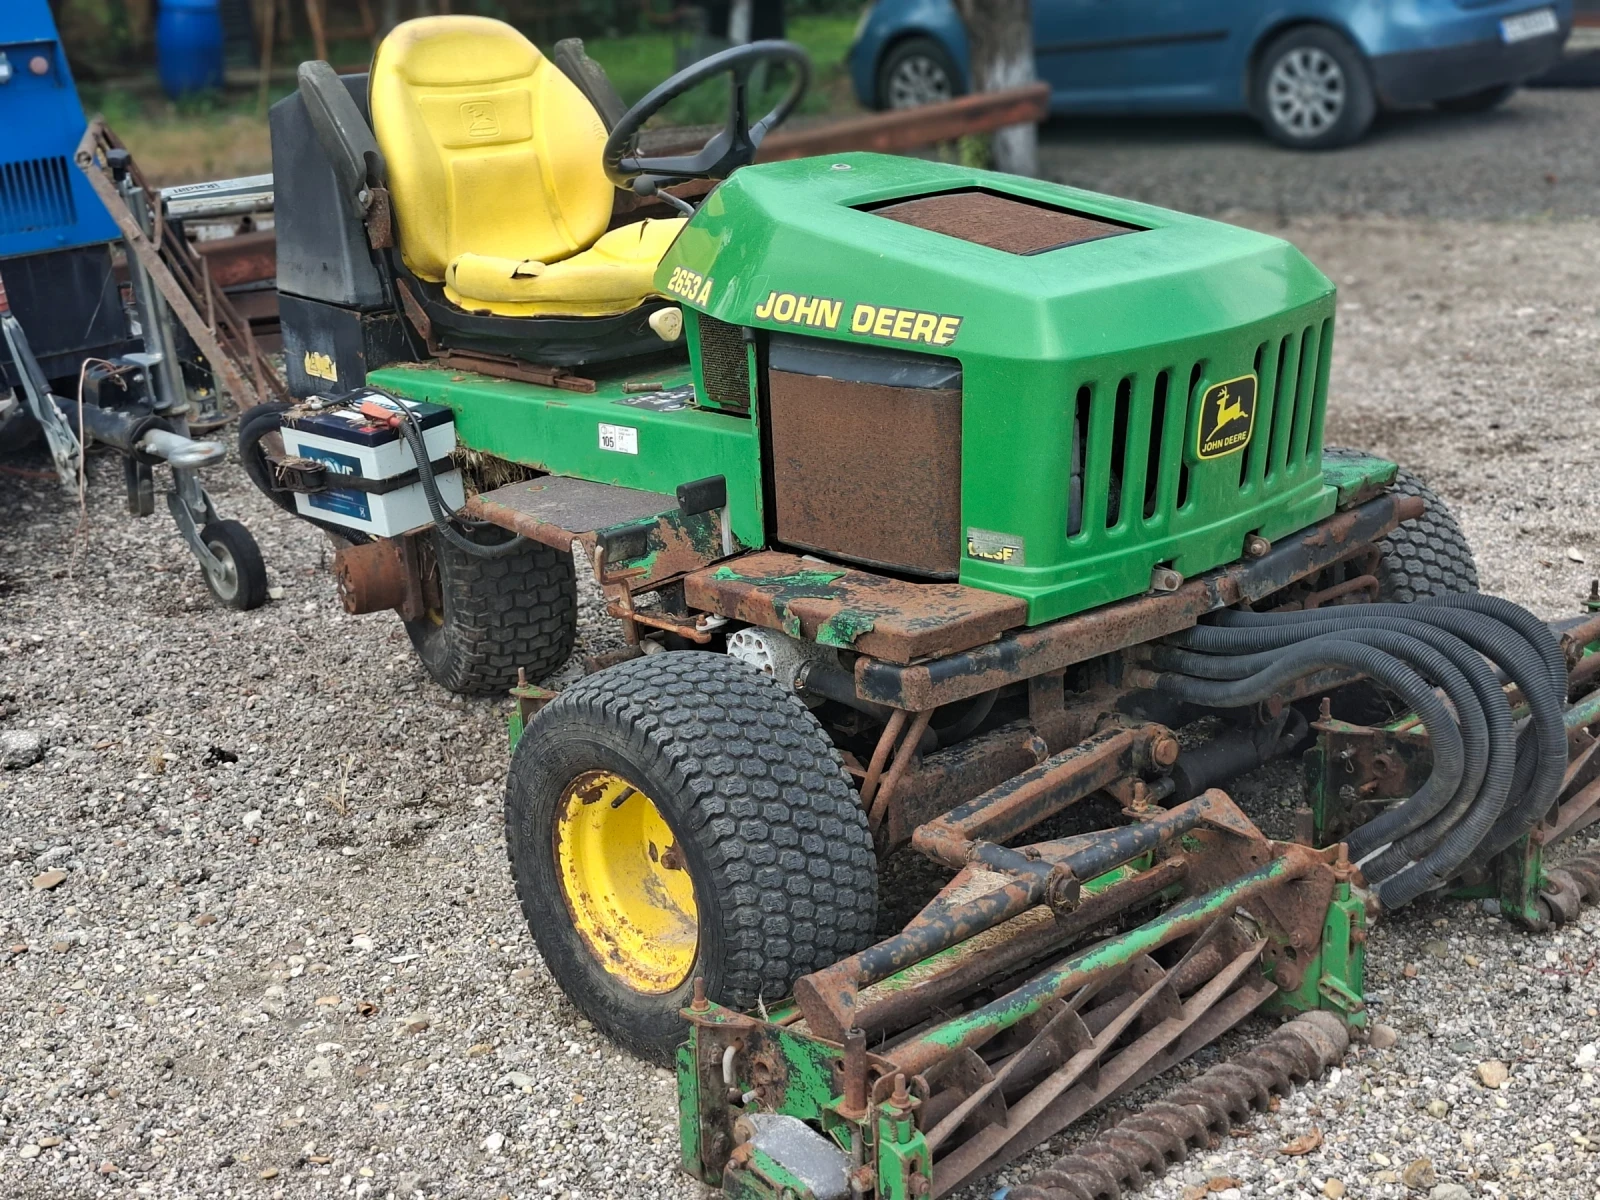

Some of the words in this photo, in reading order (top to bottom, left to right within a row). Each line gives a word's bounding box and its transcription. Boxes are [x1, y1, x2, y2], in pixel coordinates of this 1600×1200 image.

[755, 291, 843, 329] JOHN
[851, 304, 961, 344] DEERE
[602, 435, 615, 448] 105
[1202, 439, 1224, 453] JOHN
[1224, 430, 1248, 447] DEERE
